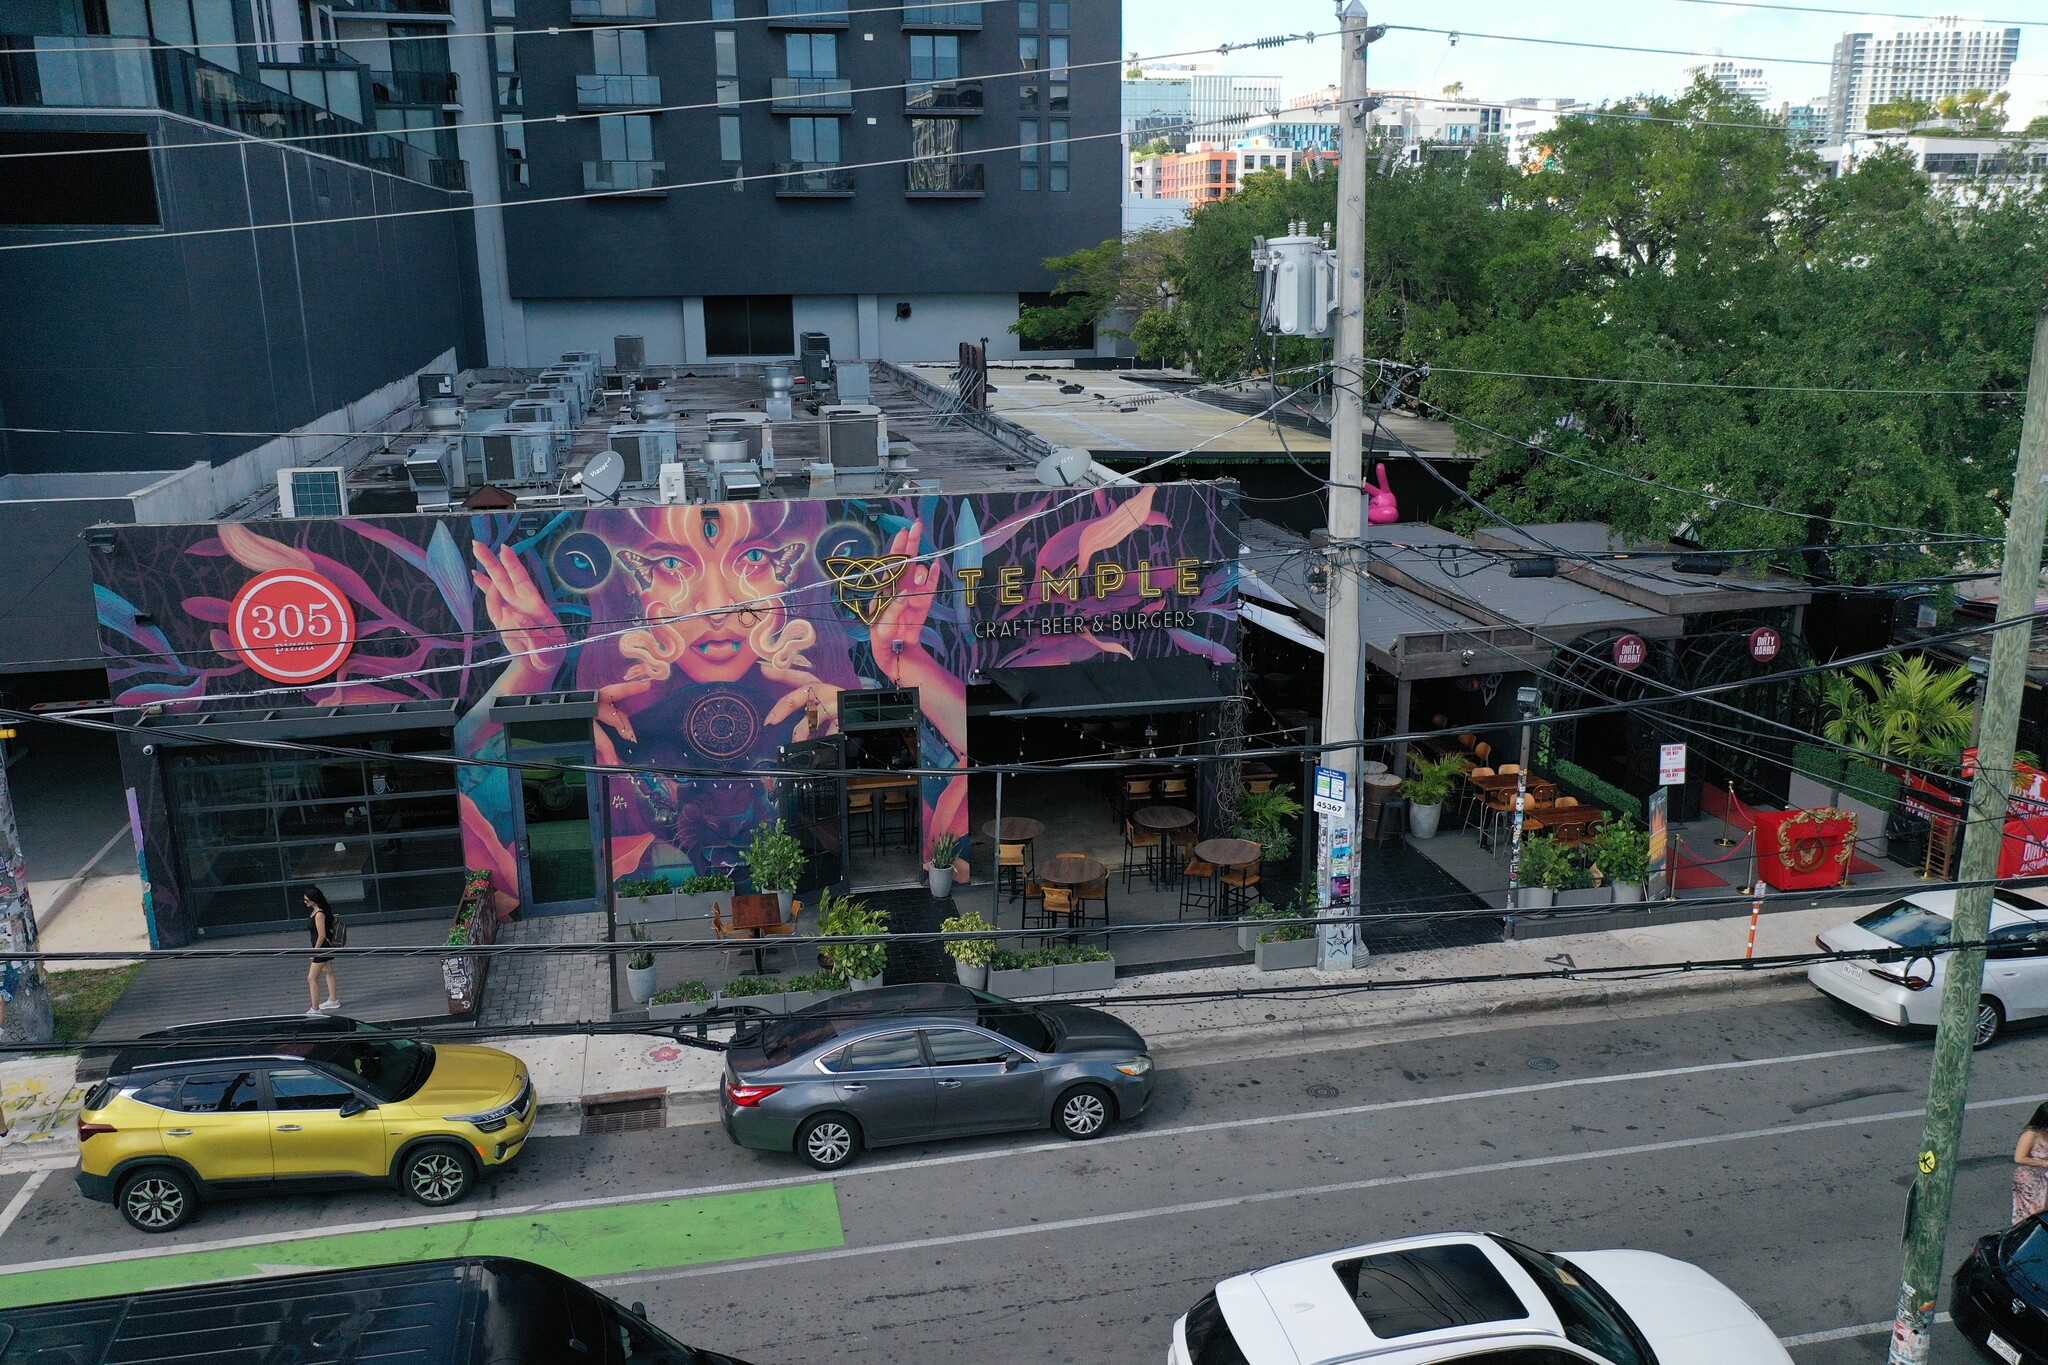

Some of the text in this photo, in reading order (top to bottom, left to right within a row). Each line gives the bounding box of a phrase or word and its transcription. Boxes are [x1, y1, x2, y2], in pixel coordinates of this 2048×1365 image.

[957, 558, 1200, 606] TEMPLE
[251, 602, 332, 640] 305
[974, 609, 1196, 639] CRAFT BEER & BURGERS
[273, 640, 315, 655] pizza
[1756, 636, 1775, 647] DIRTY
[1621, 644, 1641, 655] DIRTY
[1754, 645, 1776, 656] RABBIT
[1618, 654, 1641, 664] RABBIT
[1316, 801, 1342, 813] 45367
